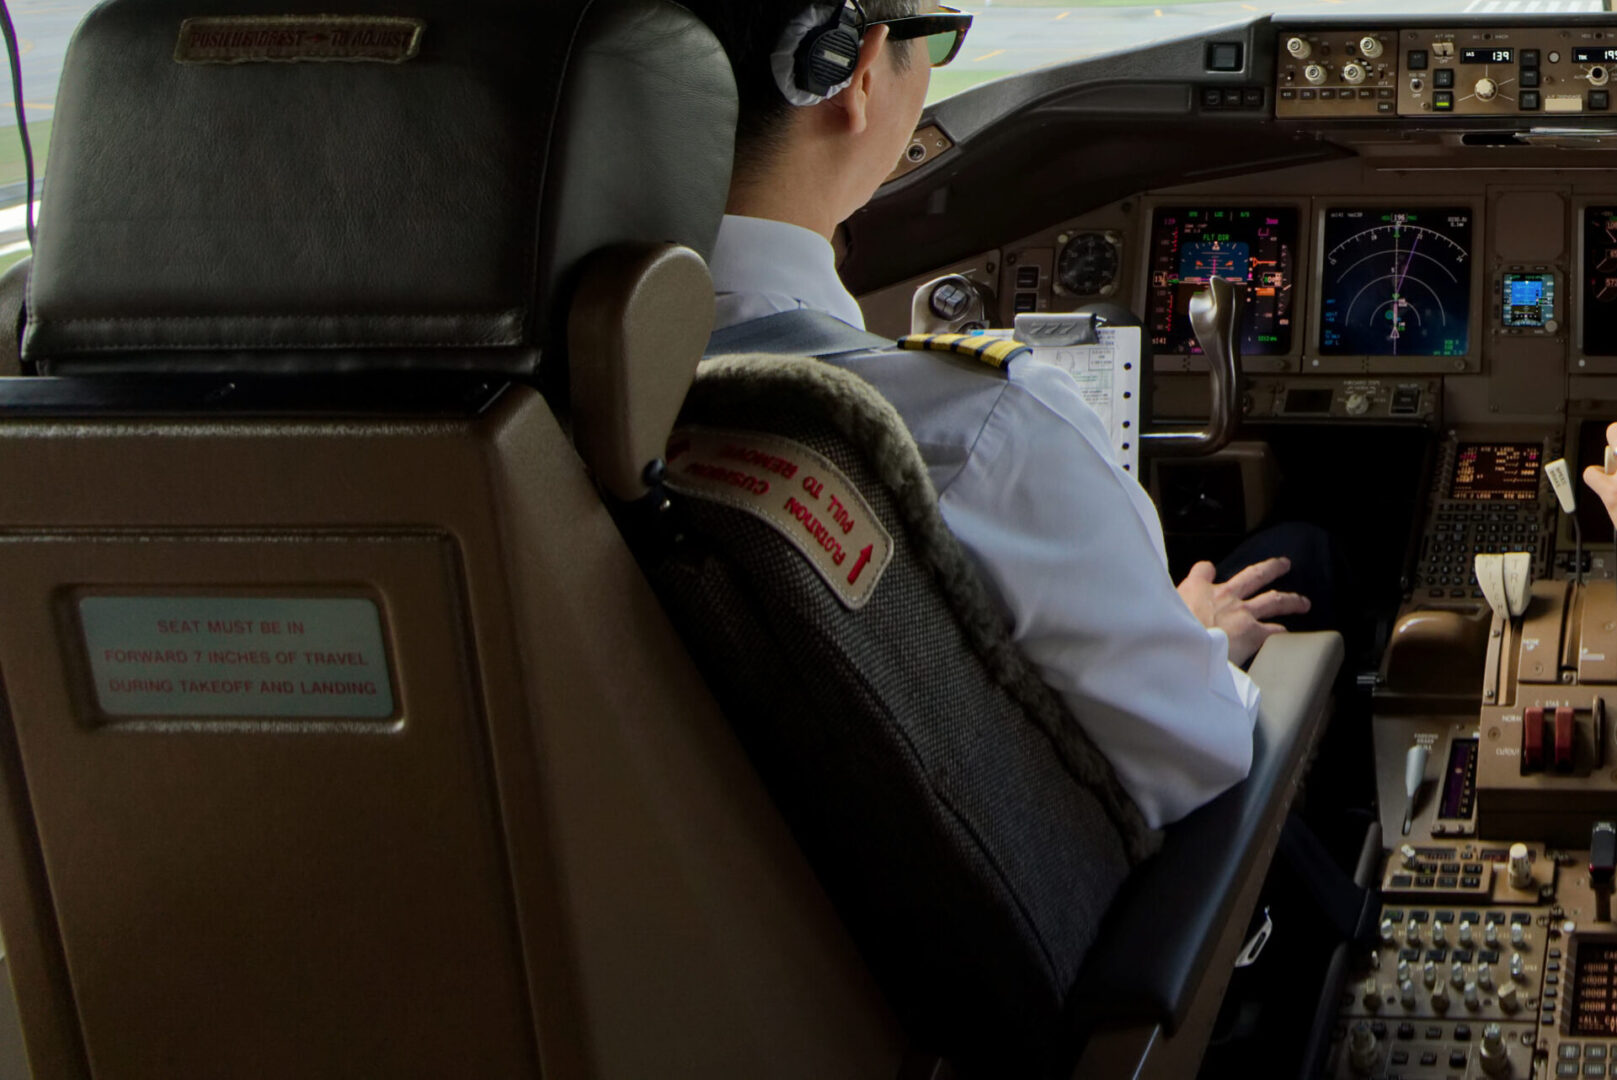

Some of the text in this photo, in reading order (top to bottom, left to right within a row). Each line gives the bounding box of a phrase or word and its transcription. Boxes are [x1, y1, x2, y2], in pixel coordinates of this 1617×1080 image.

[1492, 51, 1510, 61] 139
[1203, 233, 1229, 241] FLT DIR
[1030, 322, 1077, 335] 777
[802, 476, 824, 500] TO
[826, 494, 855, 535] PULL
[784, 497, 847, 566] FLOTATION
[157, 620, 304, 634] SEAT MUST BE IN
[104, 650, 369, 666] FORWARD 7 INCHES OF TRAVEL
[109, 679, 377, 696] DURING TAKEOFF AND LANDING
